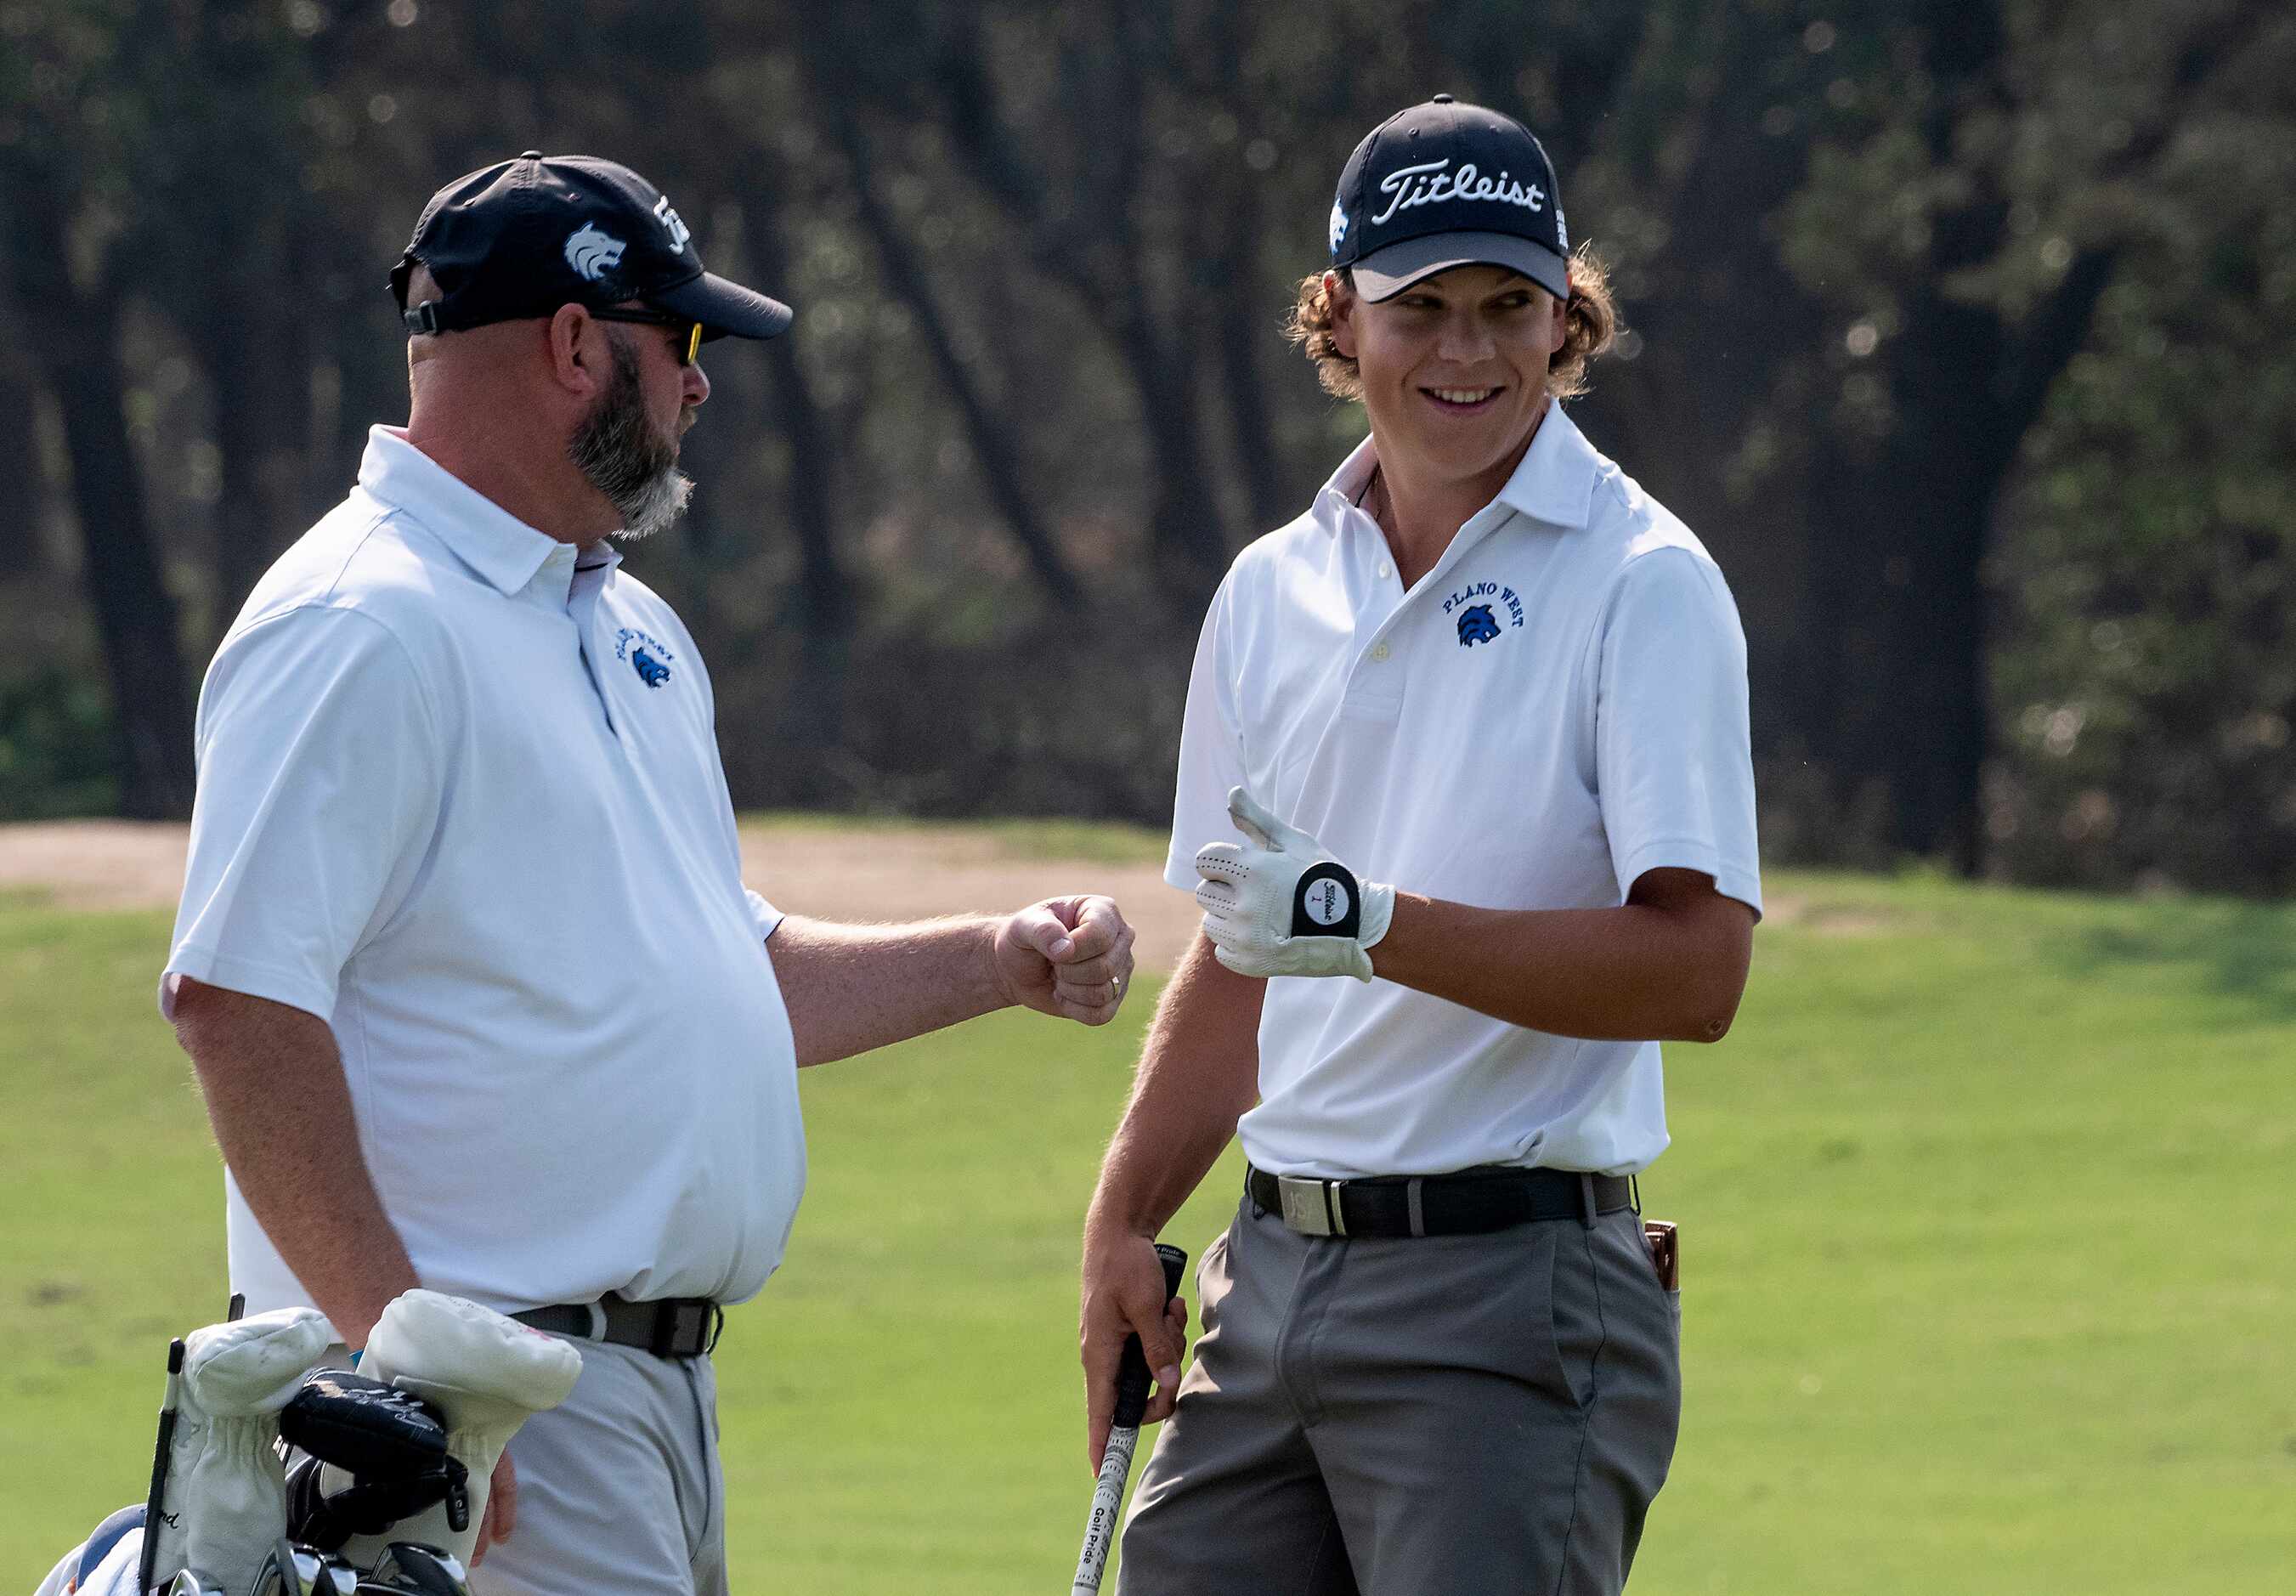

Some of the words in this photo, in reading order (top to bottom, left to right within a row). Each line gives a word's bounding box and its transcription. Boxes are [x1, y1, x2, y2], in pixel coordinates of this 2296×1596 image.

[1371, 158, 1545, 225] Titleist
[1442, 582, 1497, 614] PLANO
[1501, 586, 1524, 627] WEST
[1091, 1507, 1105, 1532] Golf
[1083, 1534, 1099, 1564] Pride
